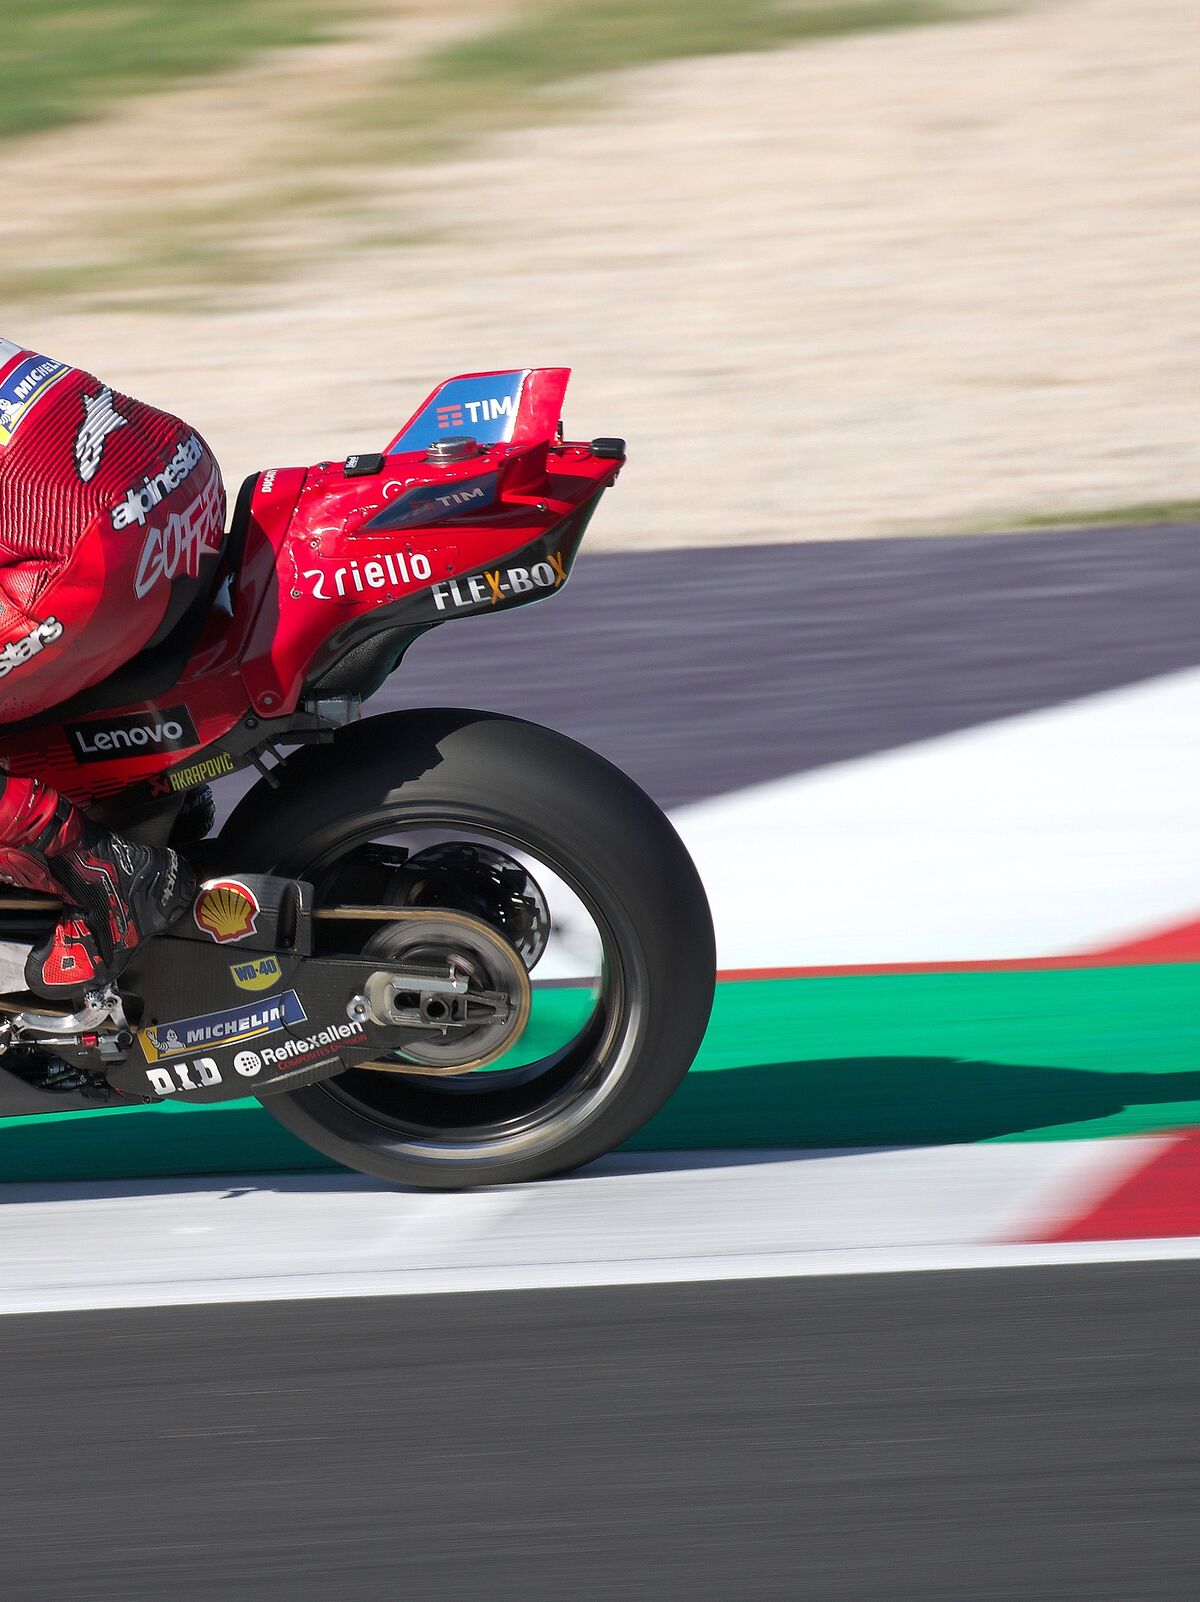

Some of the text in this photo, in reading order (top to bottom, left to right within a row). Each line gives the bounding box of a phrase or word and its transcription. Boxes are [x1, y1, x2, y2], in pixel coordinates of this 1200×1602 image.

[464, 395, 516, 425] TIM
[436, 486, 486, 508] TIM
[334, 552, 432, 594] riello
[430, 551, 567, 612] FLEX-BOX
[74, 719, 184, 754] Lenovo
[187, 1004, 287, 1045] MICHELIN
[261, 1021, 364, 1066] Reflexallen
